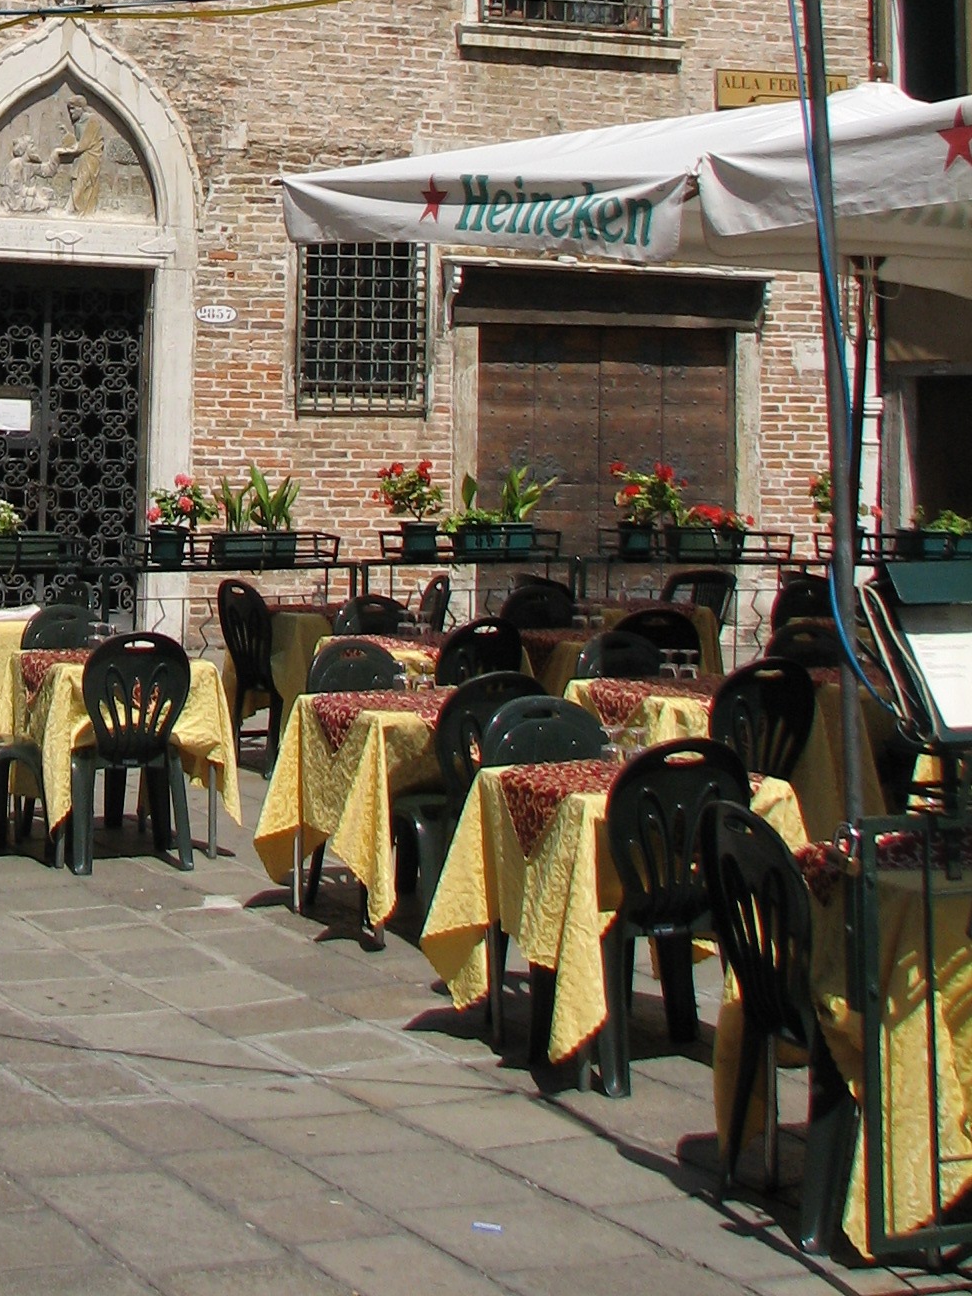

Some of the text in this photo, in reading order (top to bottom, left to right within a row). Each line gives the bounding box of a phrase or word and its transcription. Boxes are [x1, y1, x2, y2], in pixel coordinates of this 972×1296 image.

[721, 75, 842, 93] ALLA FERIA
[455, 174, 653, 247] Heineken
[199, 307, 232, 320] 2857
